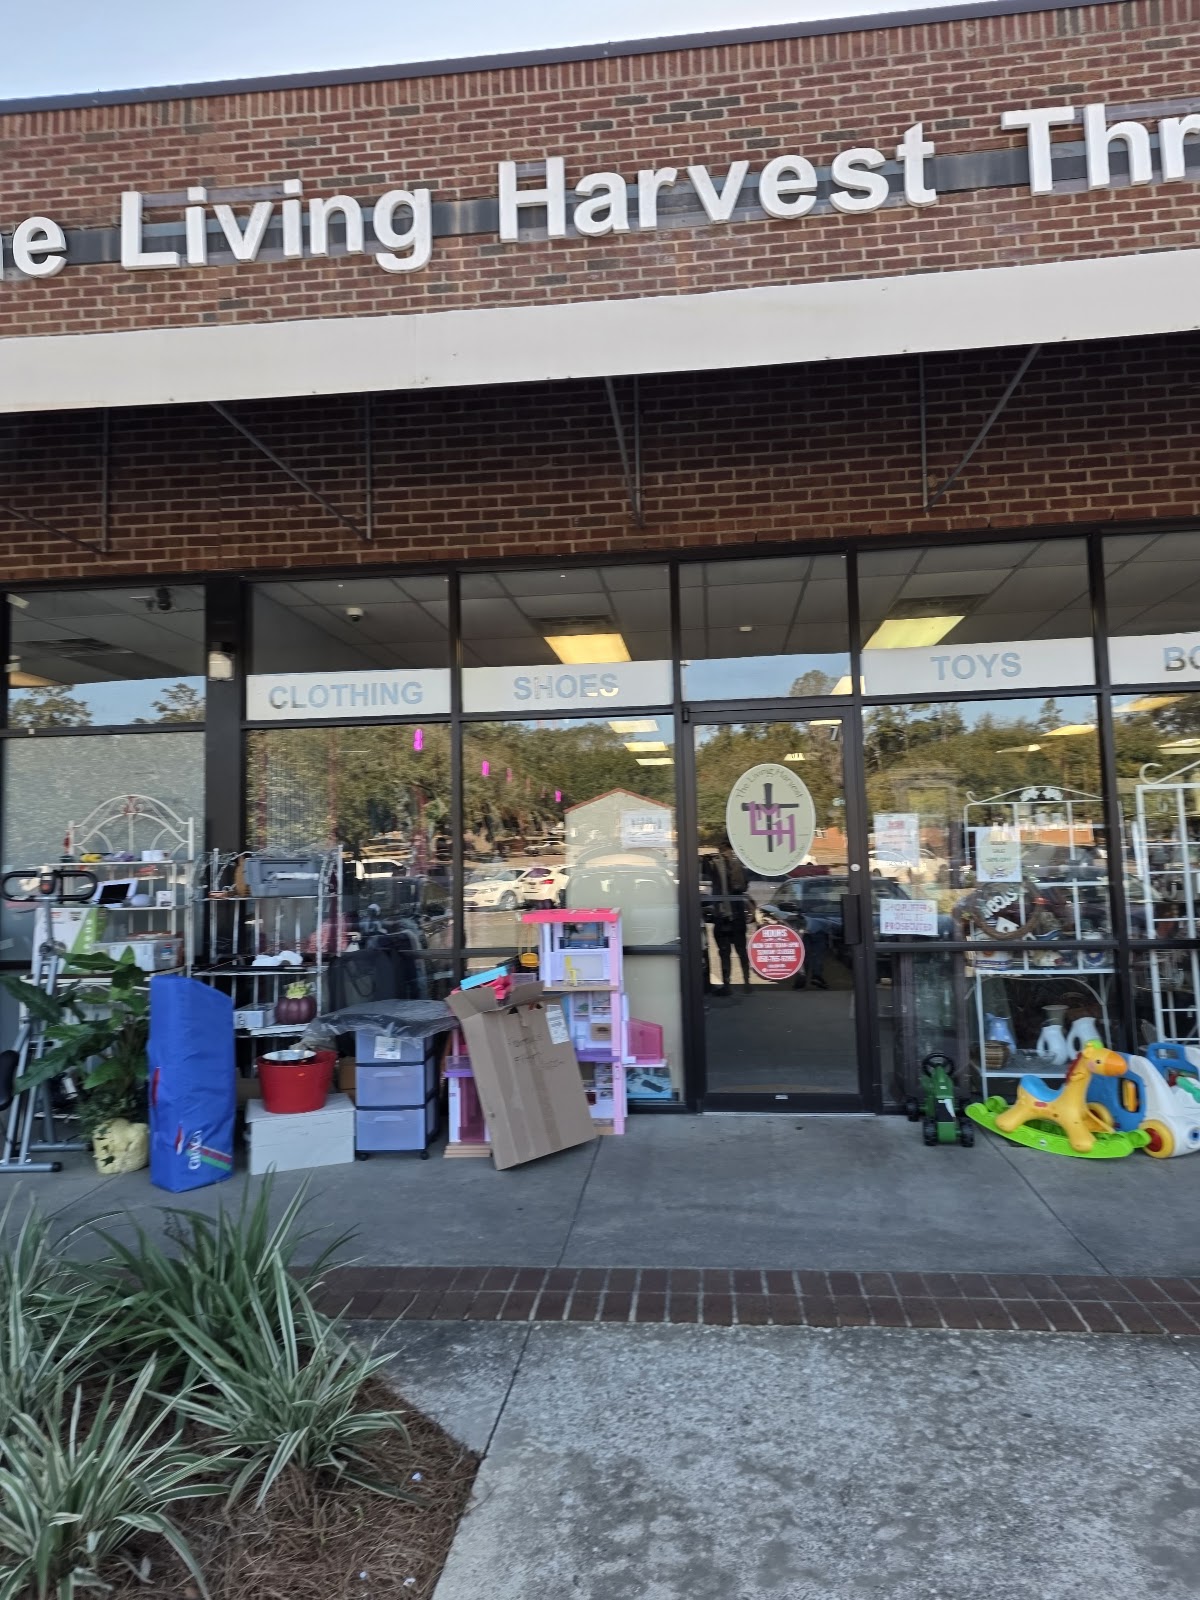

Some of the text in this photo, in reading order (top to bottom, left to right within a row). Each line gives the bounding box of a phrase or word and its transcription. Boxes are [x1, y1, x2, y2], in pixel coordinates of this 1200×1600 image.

[0, 216, 68, 279] e
[121, 178, 432, 274] Living
[498, 123, 937, 243] Harvest
[930, 652, 1022, 681] TOYS
[268, 681, 424, 709] CLOTHING
[514, 673, 619, 700] SHOES
